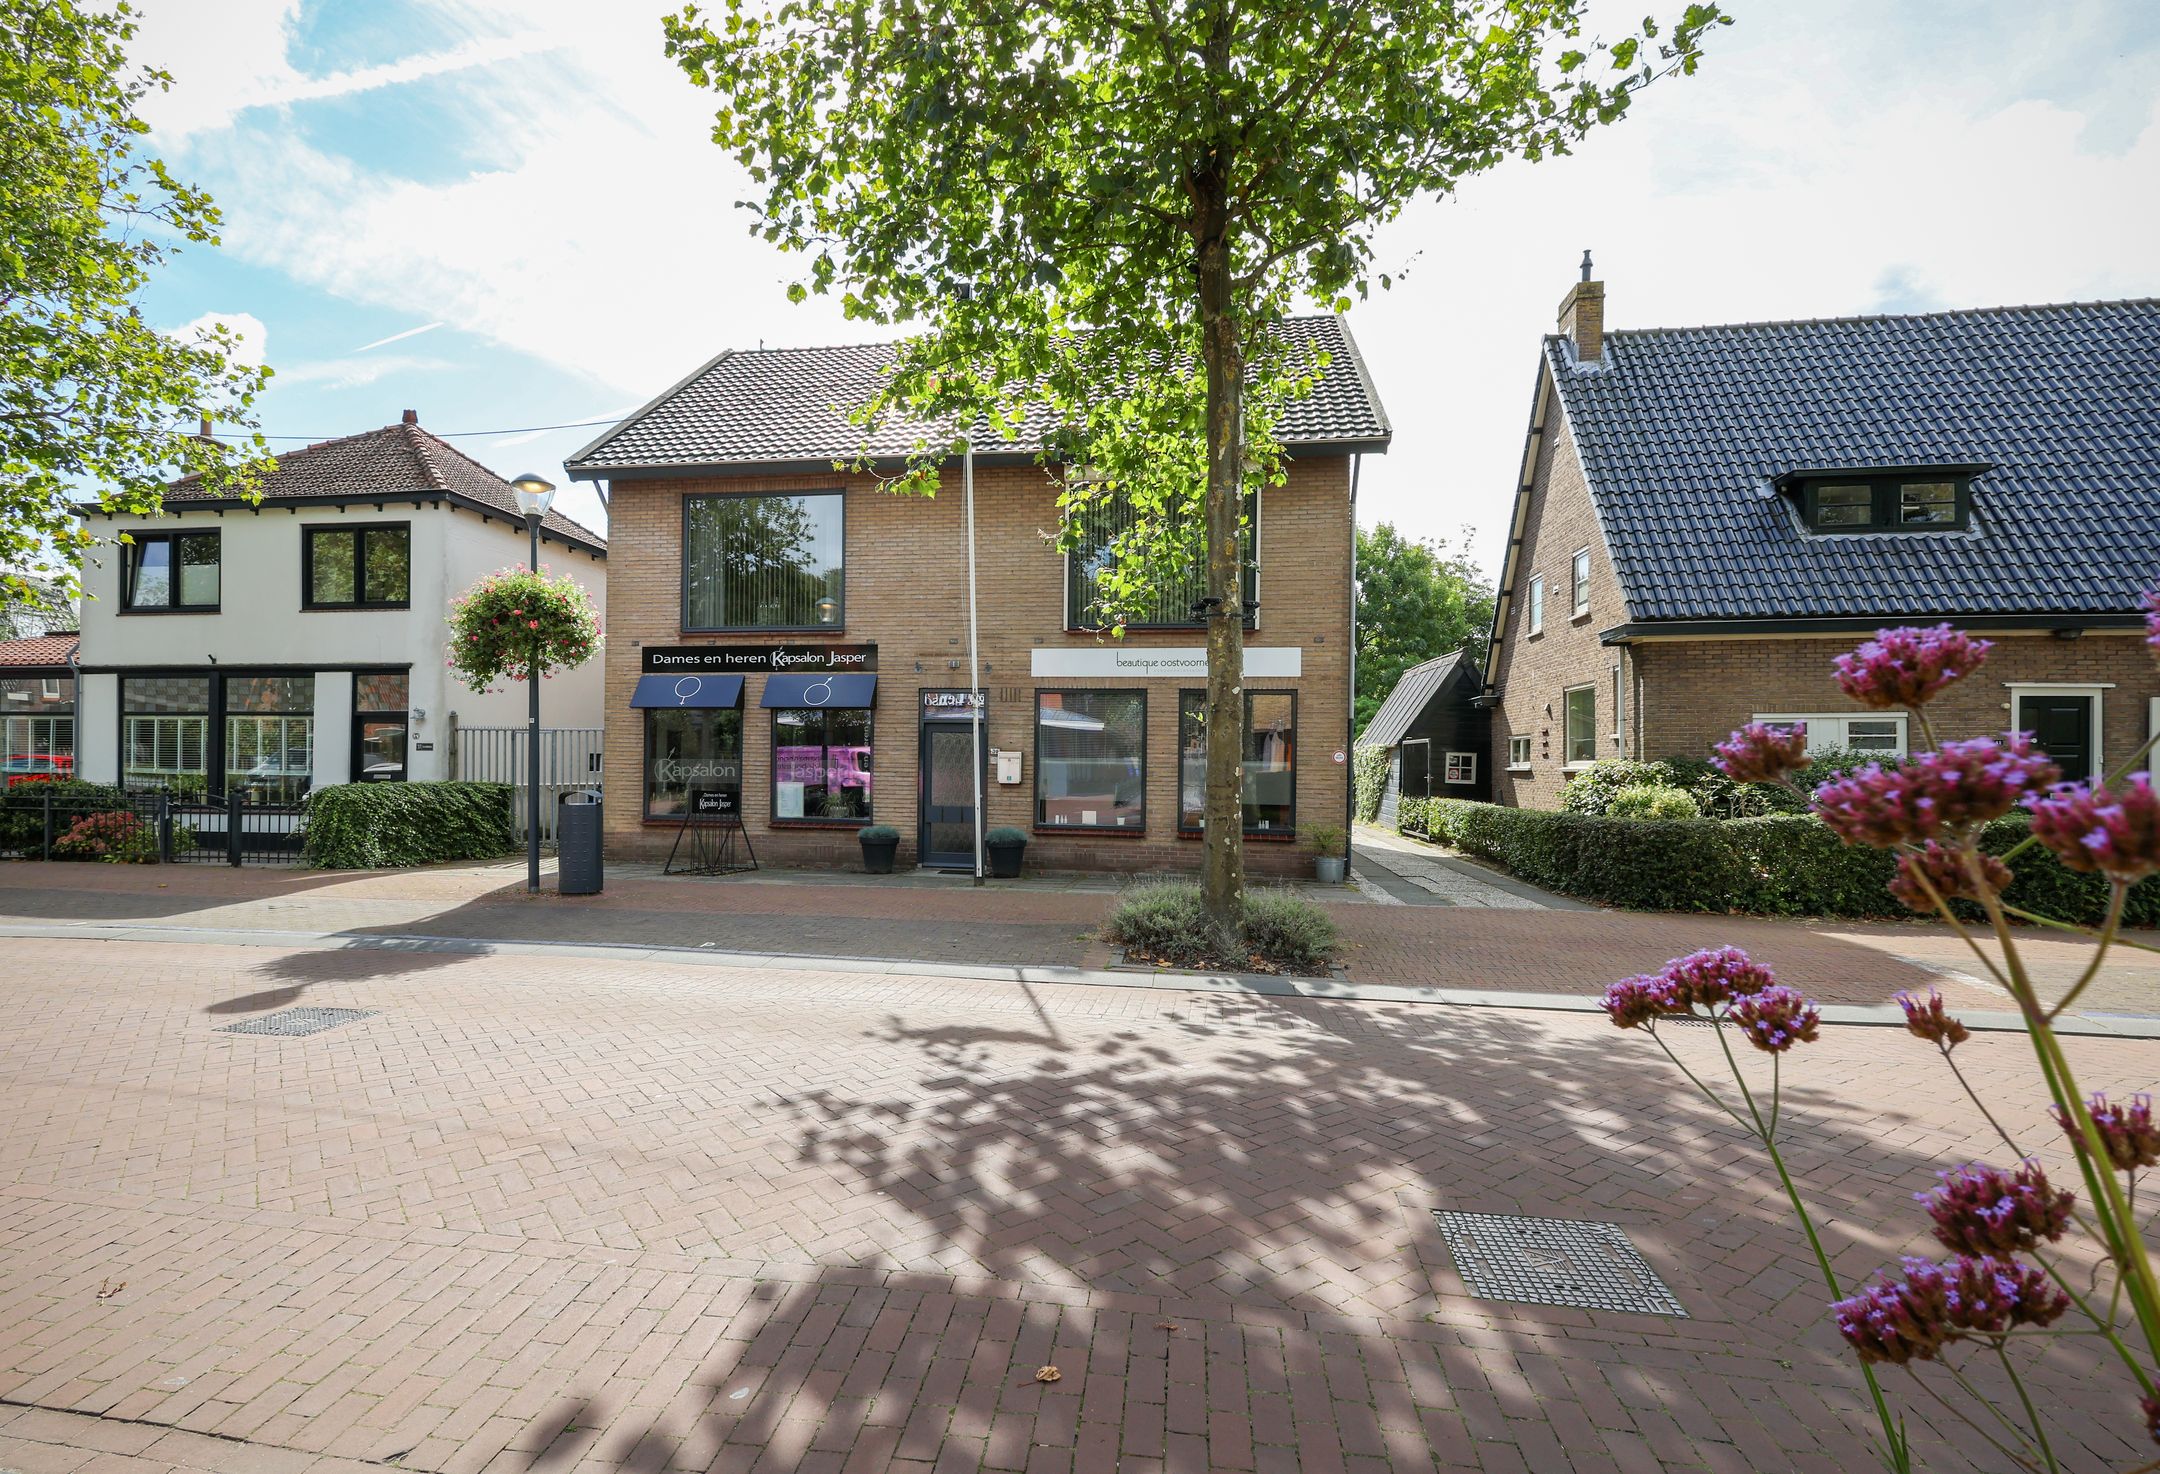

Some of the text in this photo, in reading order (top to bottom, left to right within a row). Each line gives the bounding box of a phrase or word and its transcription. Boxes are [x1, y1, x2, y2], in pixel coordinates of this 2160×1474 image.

[652, 650, 867, 667] Dames en heren Kapsalon Jasper
[1116, 651, 1158, 675] beautique
[654, 759, 735, 782] Kapsalon
[790, 761, 844, 782] Jasper
[699, 798, 731, 810] Kapsalon Jasper
